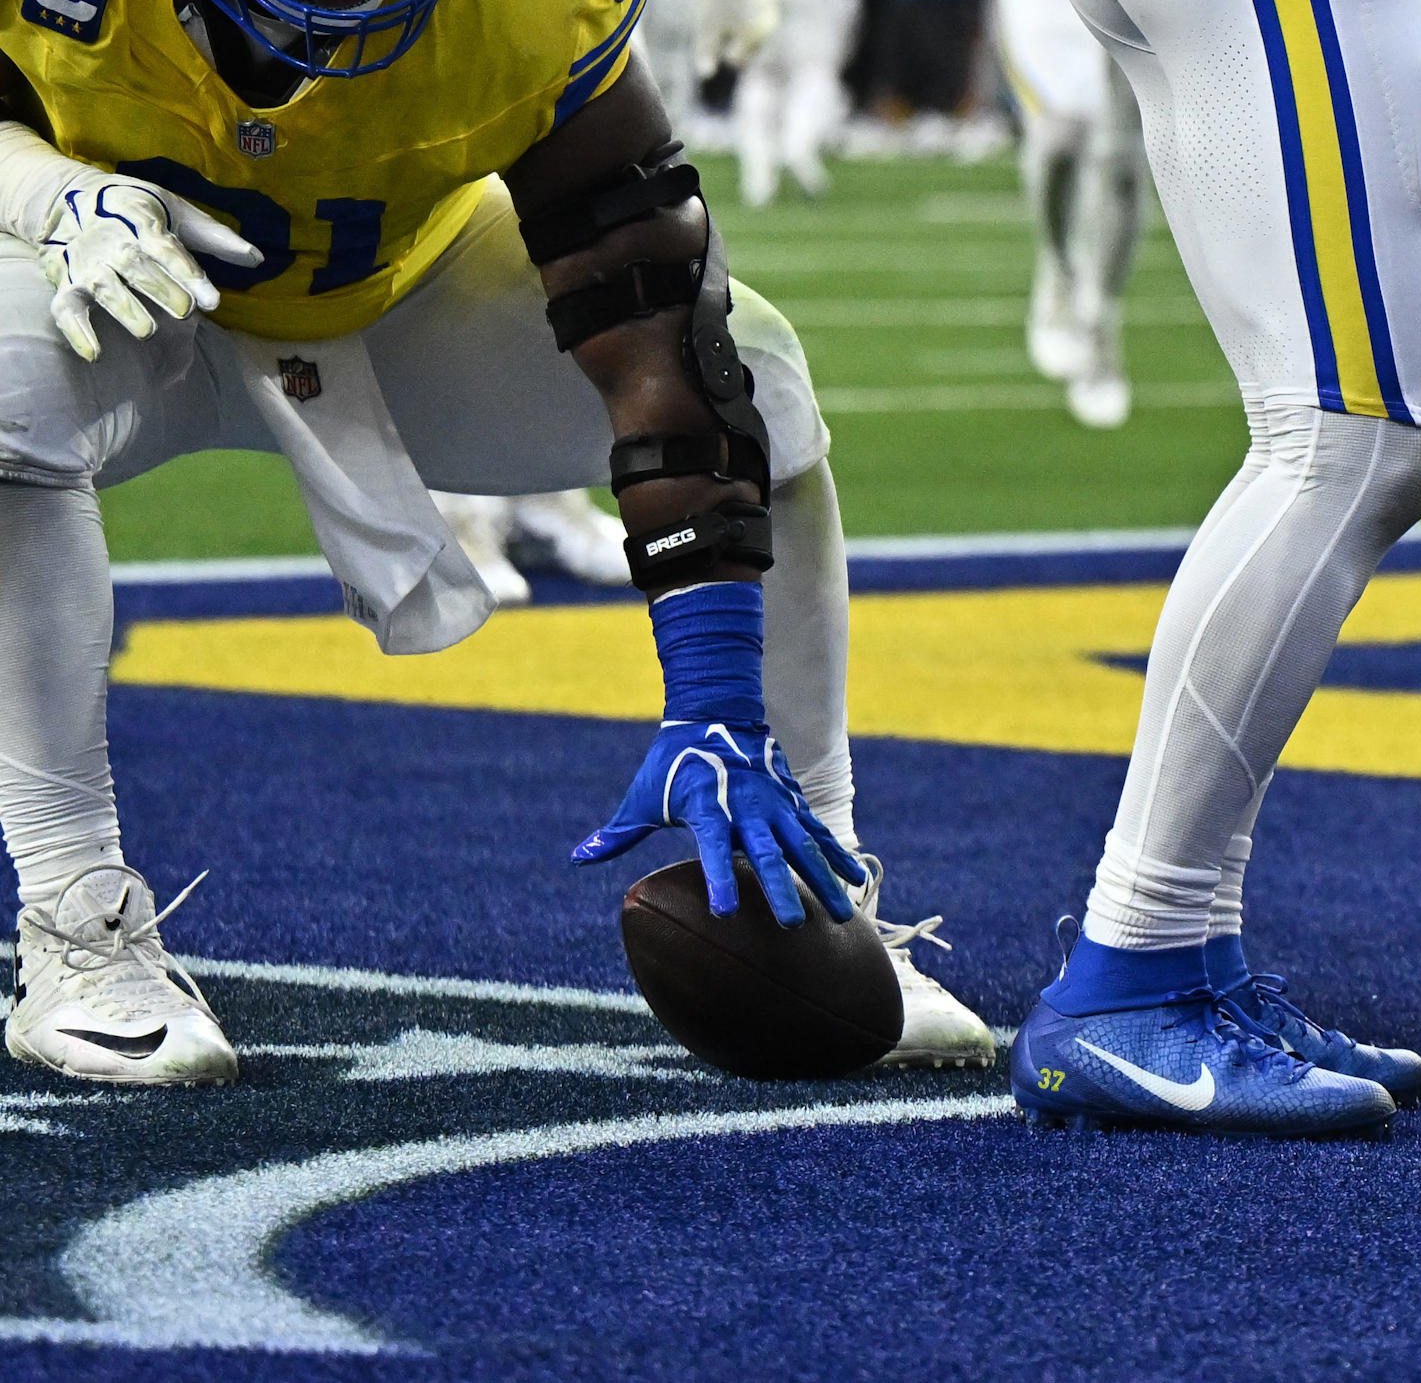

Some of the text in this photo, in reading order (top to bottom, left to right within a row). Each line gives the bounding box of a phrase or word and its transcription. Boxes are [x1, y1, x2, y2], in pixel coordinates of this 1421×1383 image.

[243, 136, 269, 154] NFL
[646, 527, 697, 557] BREG
[1037, 1067, 1066, 1092] 37
